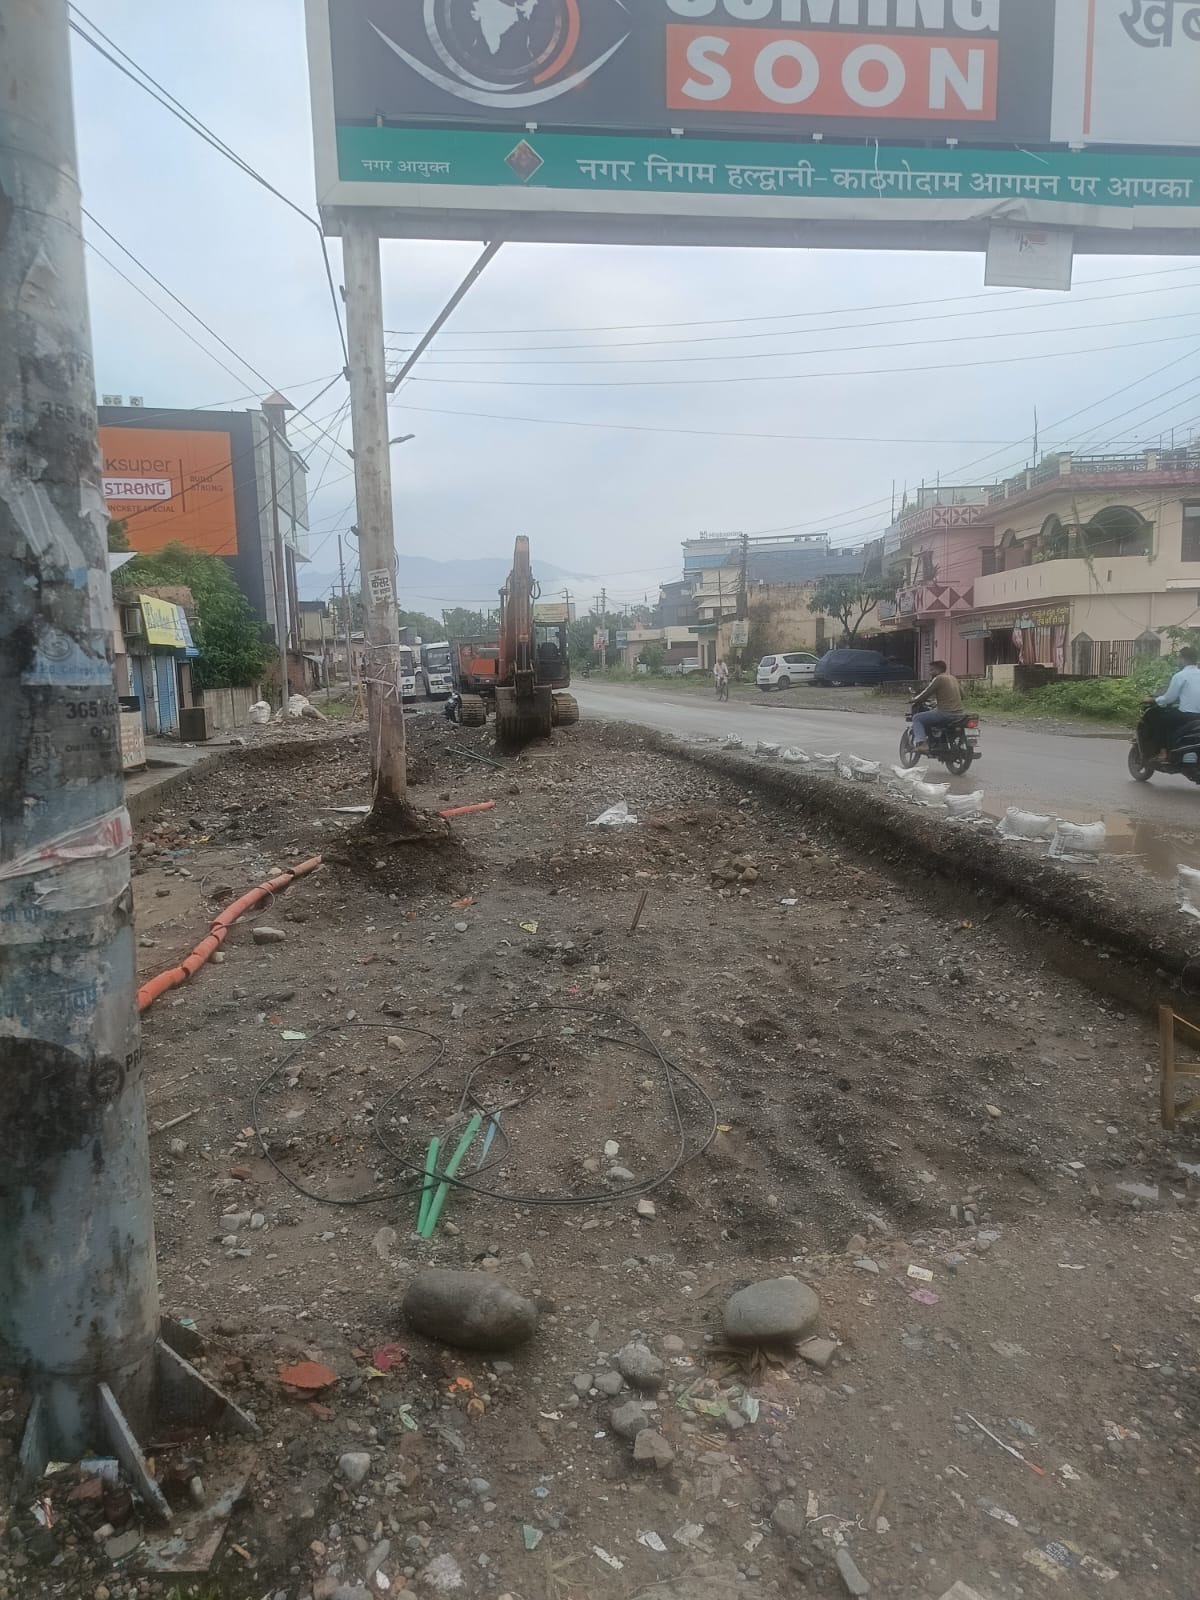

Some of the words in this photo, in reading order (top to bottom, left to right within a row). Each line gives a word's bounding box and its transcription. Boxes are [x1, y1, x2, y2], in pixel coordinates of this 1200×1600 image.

[681, 35, 985, 110] SOON
[361, 159, 393, 173] नगर
[397, 160, 451, 178] आयुक्त
[576, 159, 636, 182] नगर
[643, 153, 717, 185] निगम
[969, 172, 1061, 195] आगमन
[1067, 176, 1101, 198] पर
[1107, 177, 1193, 198] आपका
[104, 482, 166, 496] STRONG
[65, 701, 98, 719] 365
